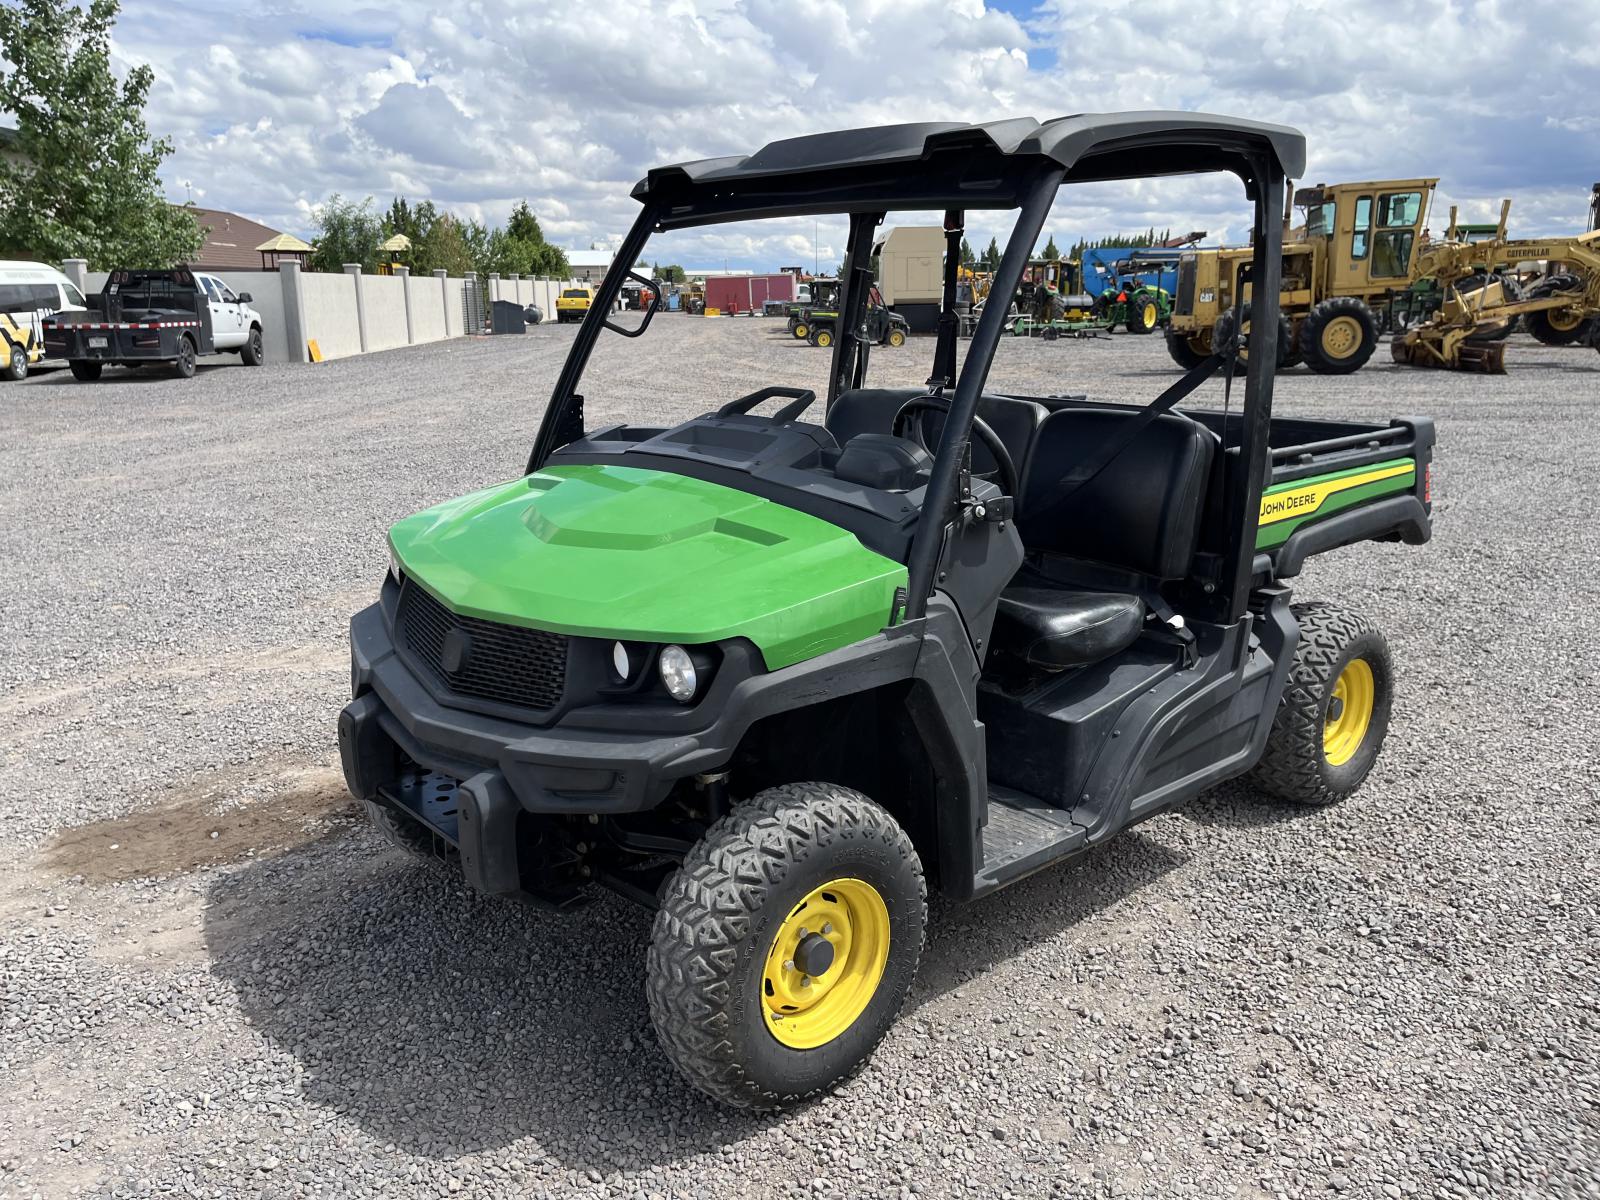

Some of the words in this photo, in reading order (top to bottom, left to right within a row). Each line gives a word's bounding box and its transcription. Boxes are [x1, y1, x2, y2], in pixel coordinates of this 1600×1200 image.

[1507, 248, 1550, 257] CATERPILLAR
[1199, 293, 1214, 303] CAT
[1260, 500, 1285, 517] JOHN
[1287, 493, 1316, 510] DEERE
